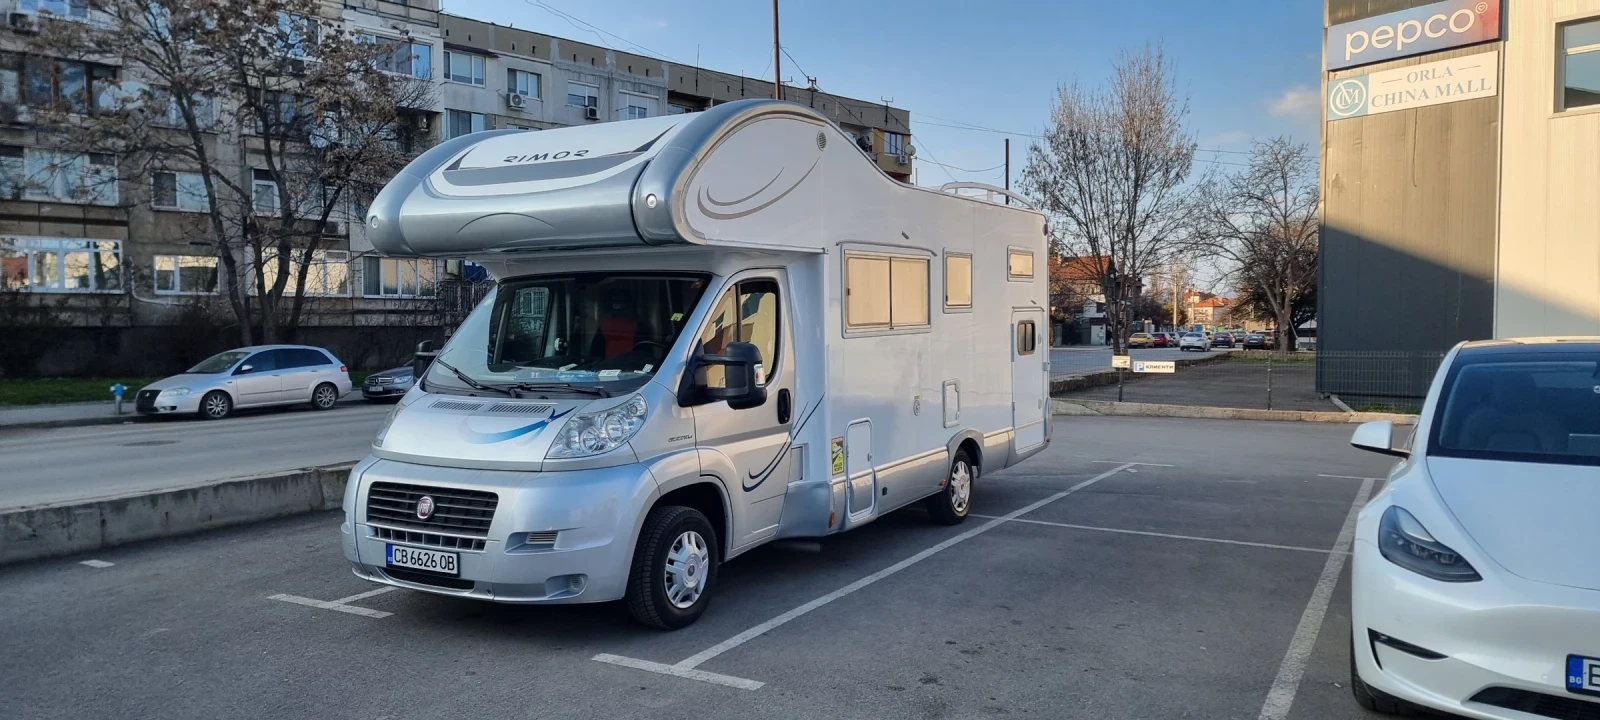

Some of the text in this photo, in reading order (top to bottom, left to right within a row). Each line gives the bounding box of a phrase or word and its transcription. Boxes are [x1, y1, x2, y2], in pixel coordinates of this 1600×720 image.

[1345, 8, 1475, 61] pepco
[1406, 66, 1453, 84] ORLA
[1371, 77, 1492, 108] CHINA MALL
[394, 548, 409, 565] CB
[410, 550, 438, 569] 6626
[1569, 675, 1582, 685] BG
